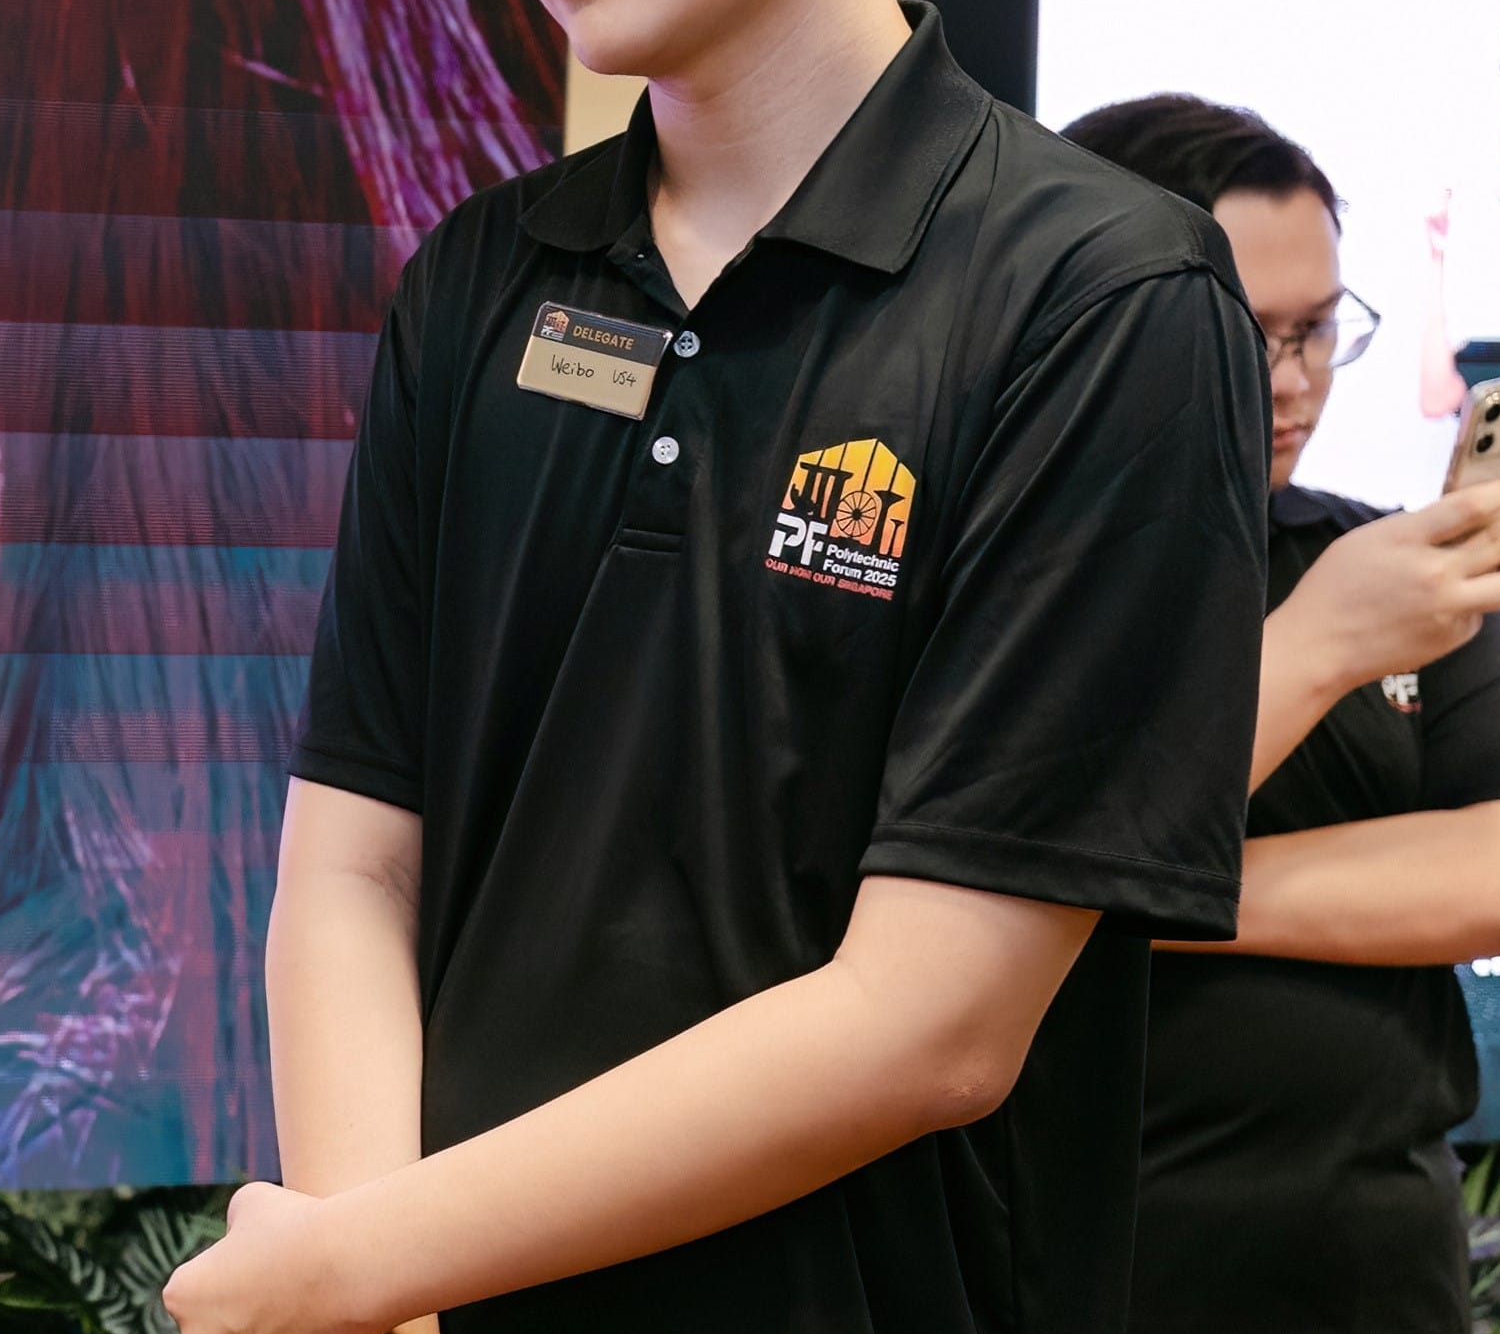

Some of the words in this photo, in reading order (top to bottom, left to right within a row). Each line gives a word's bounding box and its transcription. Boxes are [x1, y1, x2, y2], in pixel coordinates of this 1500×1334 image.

[572, 325, 635, 350] DELEGATE
[551, 354, 595, 378] Weibo
[768, 512, 828, 566] PF
[765, 558, 788, 573] OUR
[812, 572, 836, 585] OUR
[826, 544, 900, 572] Polytechnic
[822, 559, 862, 579] Forum
[863, 569, 897, 587] 2025
